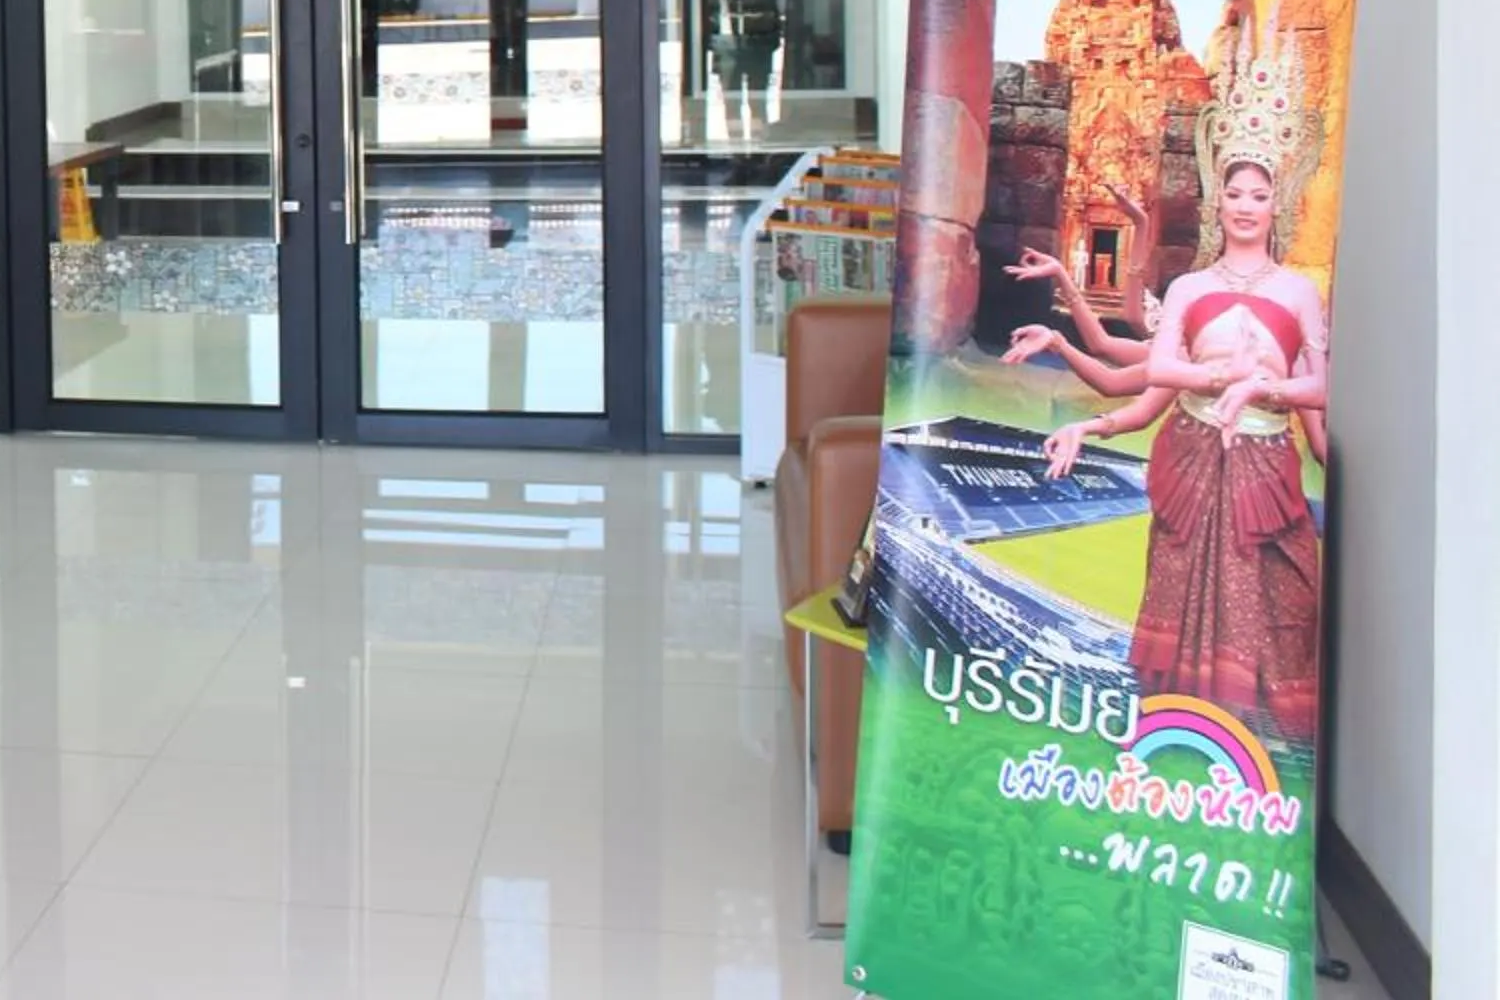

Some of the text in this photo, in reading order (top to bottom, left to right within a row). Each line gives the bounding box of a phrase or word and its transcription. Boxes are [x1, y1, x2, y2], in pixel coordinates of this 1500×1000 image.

[940, 463, 1040, 489] THUNDER
[923, 647, 1139, 745] บุรีรัมย์
